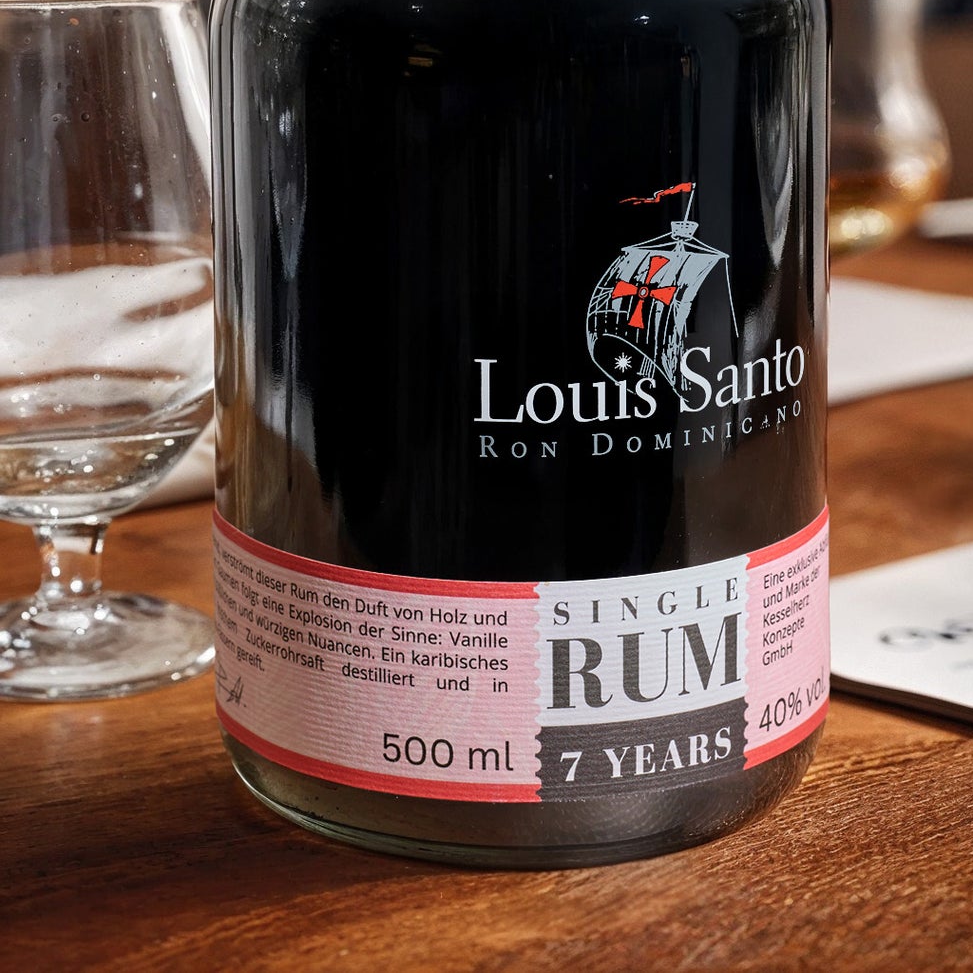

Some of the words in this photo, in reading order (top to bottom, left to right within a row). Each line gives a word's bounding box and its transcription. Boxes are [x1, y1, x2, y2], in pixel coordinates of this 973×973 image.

[474, 359, 657, 424] Louis
[679, 339, 805, 413] Santo
[256, 570, 287, 594] dieser
[290, 582, 319, 604] Rum
[323, 592, 350, 612] den
[355, 598, 389, 618] Duft
[393, 607, 423, 621] von
[430, 608, 468, 624] Holz
[474, 610, 508, 626] und
[553, 577, 739, 626] SINGLE
[763, 570, 785, 590] Eine
[763, 587, 783, 609] und
[786, 575, 810, 599] Marke
[242, 581, 260, 607] folgt
[262, 595, 285, 616] eine
[289, 604, 352, 634] Explosion
[359, 621, 385, 638] der
[391, 626, 442, 646] Sinne:
[449, 631, 508, 649] Vanille
[762, 617, 805, 647] Konzepte
[763, 594, 810, 628] Kesselherz
[237, 645, 265, 672] gereift.
[240, 604, 254, 623] und
[255, 614, 305, 644] würzigen
[308, 631, 376, 660] Nuancen.
[381, 646, 405, 664] Ein
[411, 649, 509, 671] karibisches
[246, 627, 325, 672] Zuckerrohrsaft
[342, 662, 416, 688] destilliert
[436, 676, 470, 692] und
[492, 678, 509, 693] in
[546, 611, 742, 710] RUM
[762, 639, 793, 666] GmbH
[759, 687, 803, 732] 40%
[382, 732, 454, 769] 500
[468, 740, 514, 772] ml
[558, 750, 583, 782] 7
[603, 726, 733, 779] YEARS
